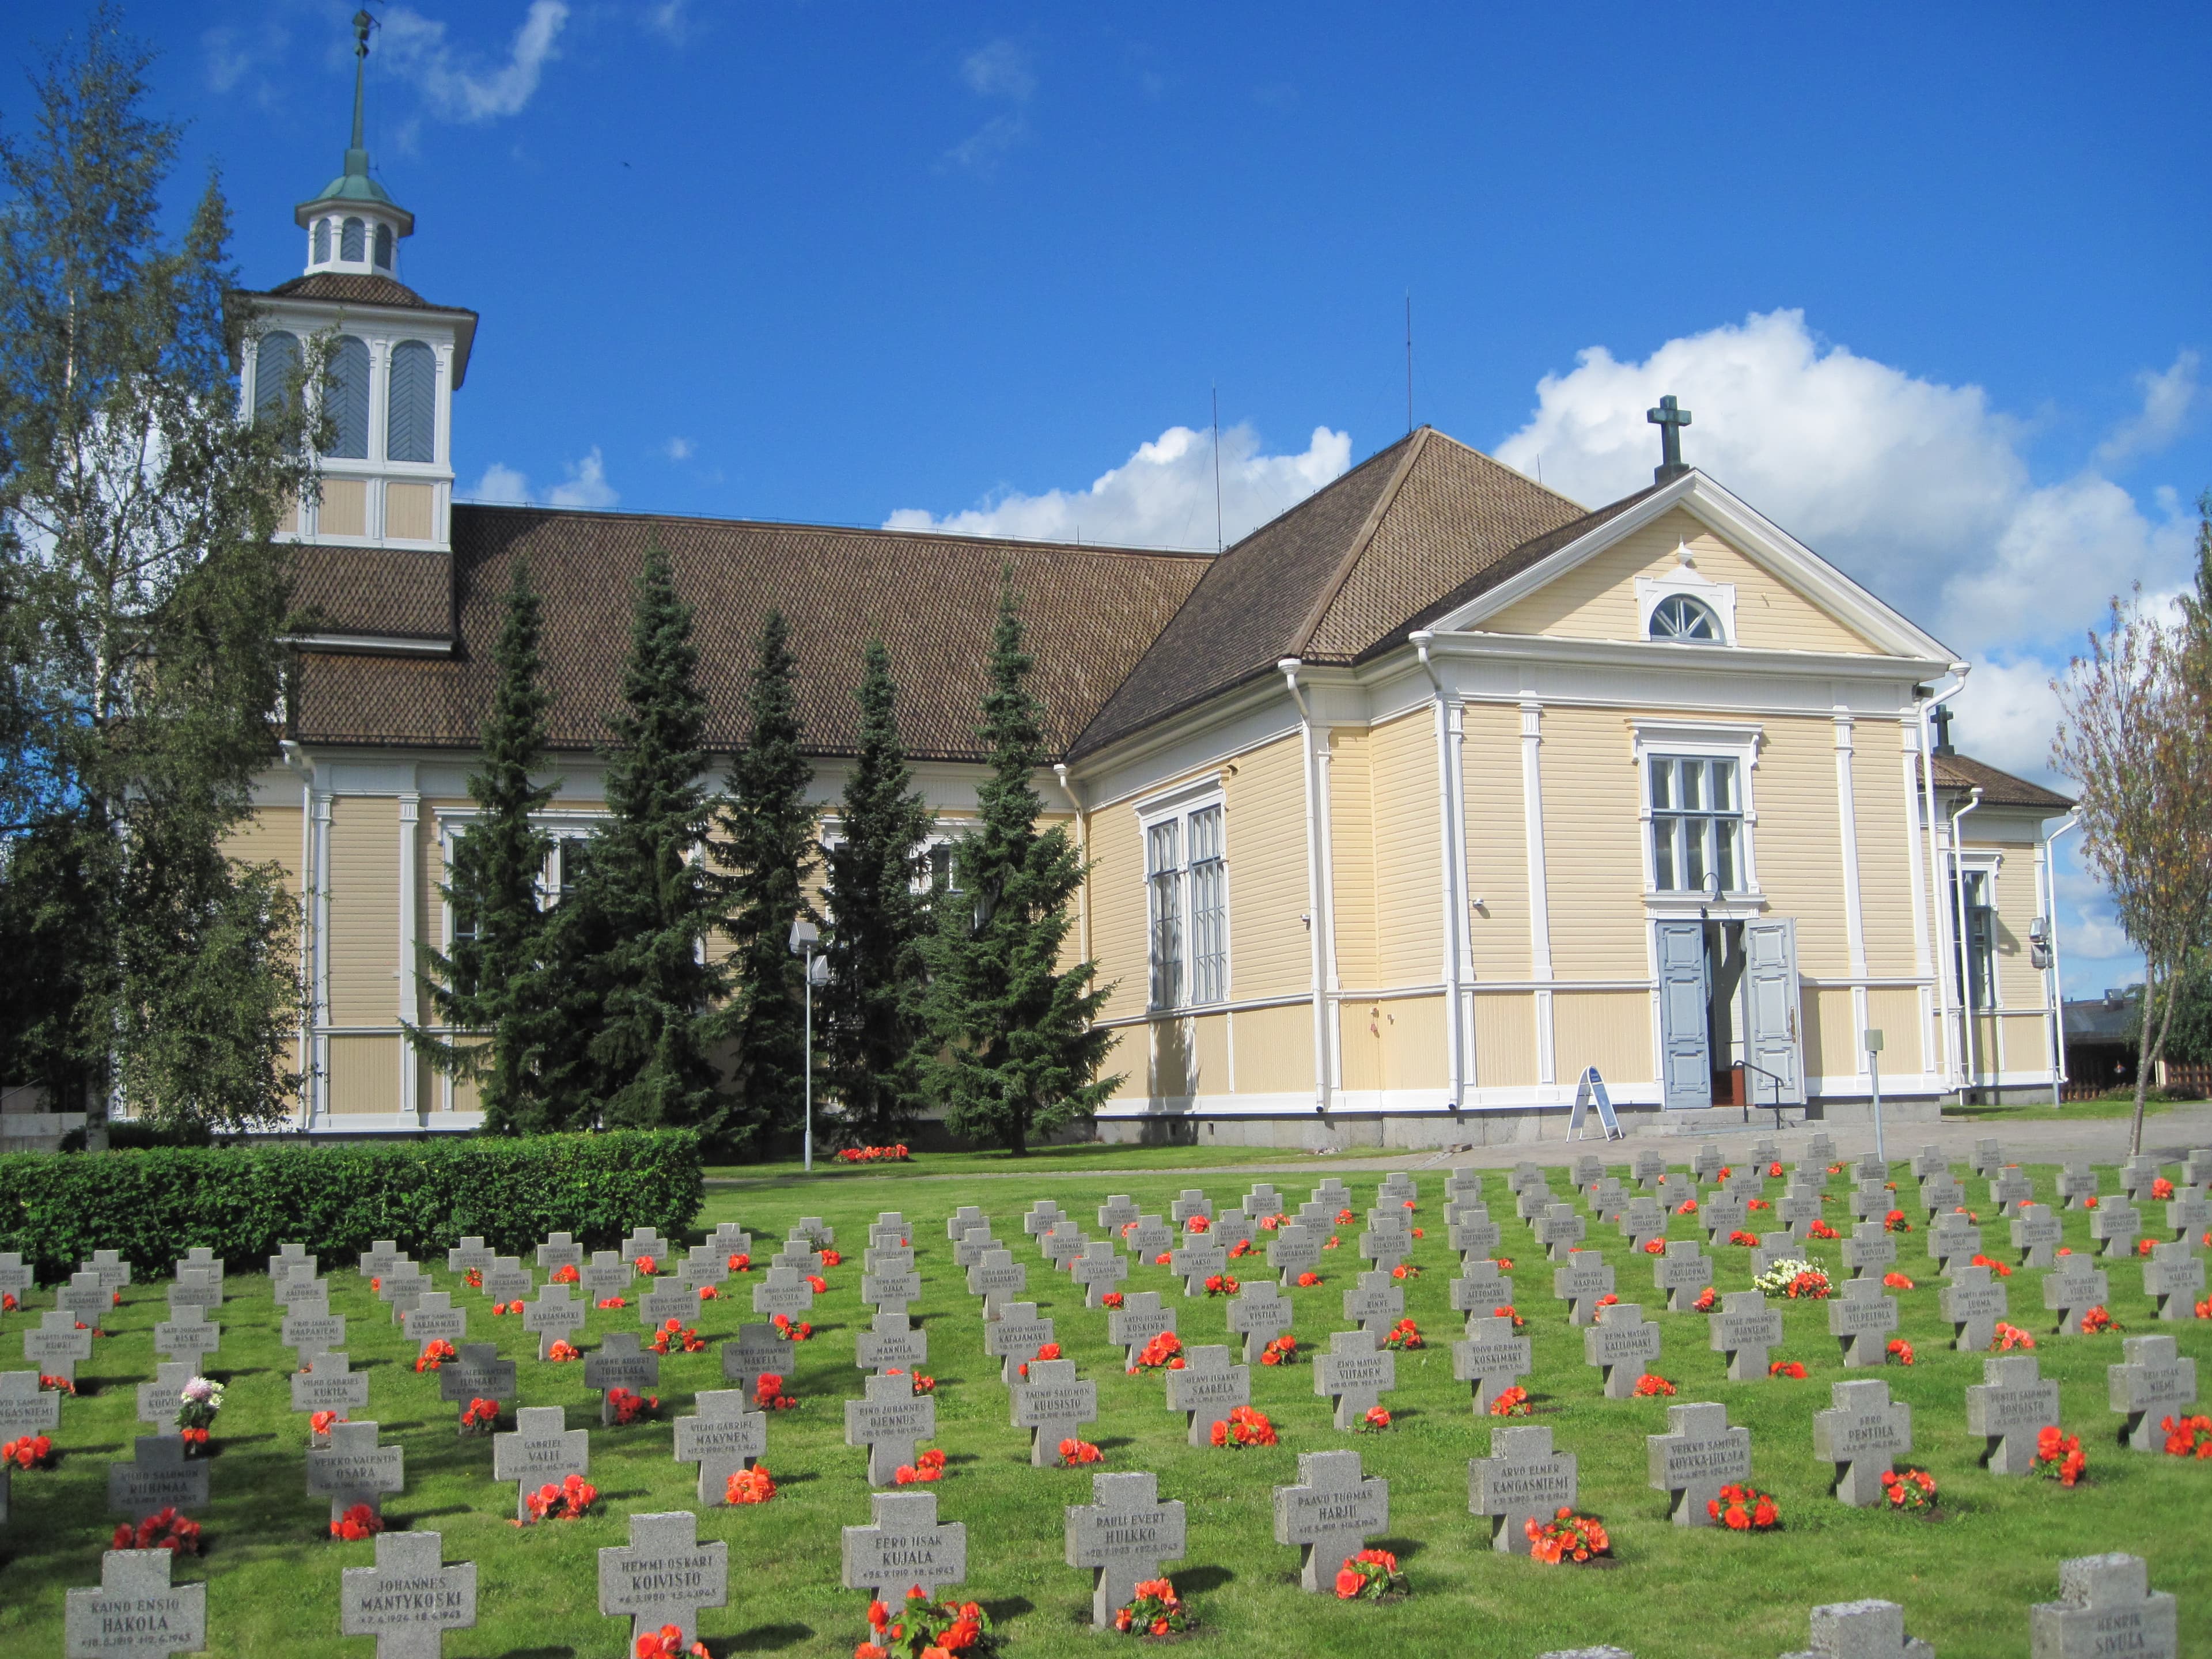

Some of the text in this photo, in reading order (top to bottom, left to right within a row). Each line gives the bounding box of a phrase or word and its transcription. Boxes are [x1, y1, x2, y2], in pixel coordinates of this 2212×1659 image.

[1968, 1299, 1990, 1308] LUOMA
[1127, 1323, 1165, 1331] KOSKINEN
[1734, 1325, 1768, 1334] OJANIEMI
[1627, 1329, 1650, 1338] MATIAS
[1494, 1343, 1521, 1351] HERMAN
[1339, 1368, 1380, 1379] VIITANEN
[1192, 1384, 1233, 1395] SAARELA
[2150, 1380, 2174, 1392] NIEMI
[1054, 1388, 1089, 1397] SALOMON
[882, 1404, 925, 1414] JOHANNES
[1034, 1399, 1081, 1411] KUUSISTO
[717, 1421, 753, 1430] GABRIEL
[870, 1415, 915, 1427] OJENNUS
[1859, 1416, 1881, 1426] EERO
[524, 1440, 562, 1449] GABRIEL
[1672, 1438, 1740, 1454] VEIKKO SAMUEL
[315, 1455, 397, 1467] VEIKKO VALENTIN
[529, 1451, 559, 1461] VALLI
[1502, 1464, 1559, 1478] ARVO ELMER
[1493, 1476, 1568, 1495] KANGASNIEMI
[1298, 1495, 1330, 1506] PAAVO
[1319, 1505, 1357, 1520] HARJU
[1096, 1513, 1165, 1527] PAULI EVERT
[1105, 1528, 1156, 1544] HULKKO
[875, 1538, 907, 1550] EERO
[668, 1556, 713, 1569] OSKARI
[882, 1551, 933, 1565] KUJALA
[377, 1578, 446, 1592] JOHANNES
[632, 1572, 701, 1590] KOIVISTO
[138, 1599, 180, 1612] ENSIO
[103, 1616, 169, 1633] HAKOLA
[2097, 1613, 2141, 1632] HENRIK
